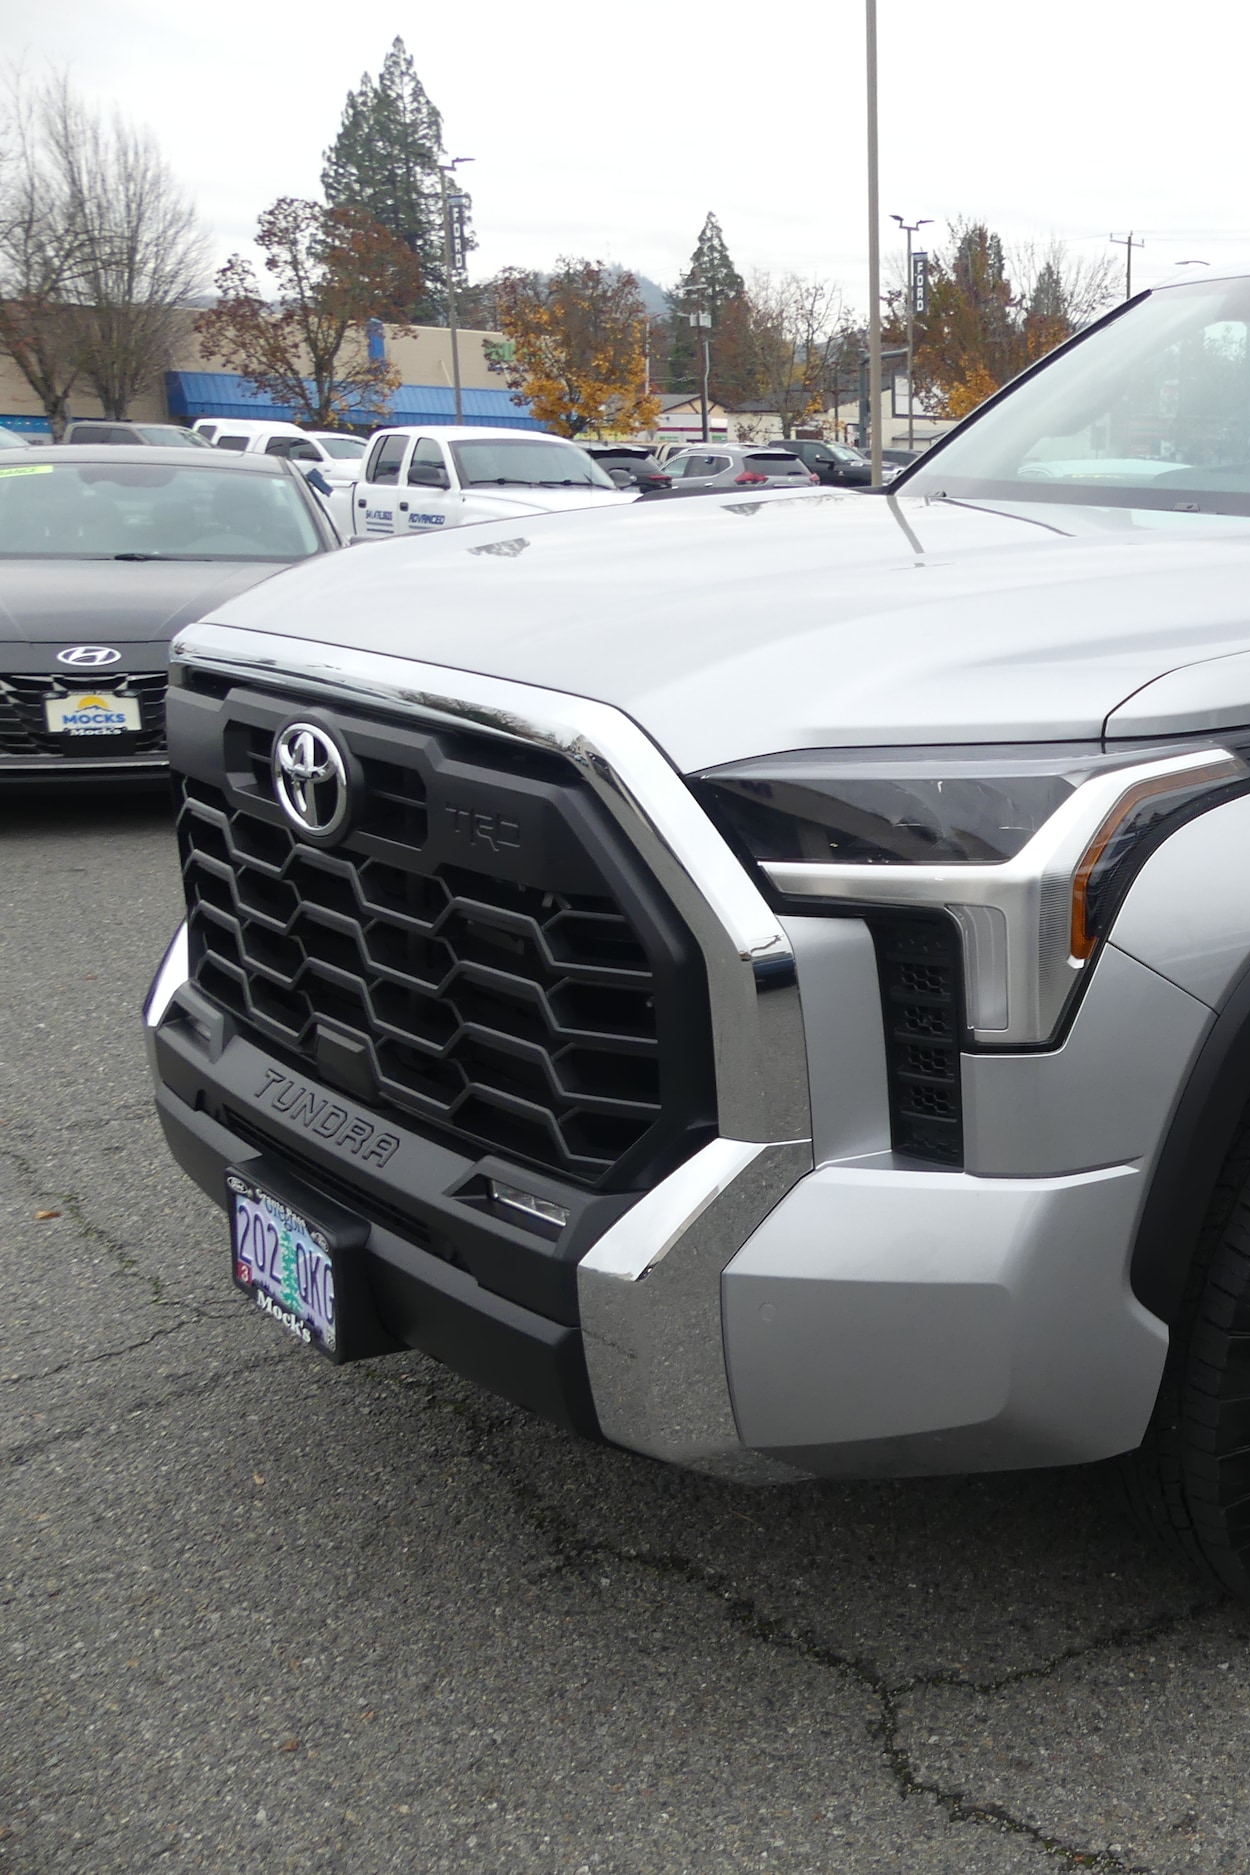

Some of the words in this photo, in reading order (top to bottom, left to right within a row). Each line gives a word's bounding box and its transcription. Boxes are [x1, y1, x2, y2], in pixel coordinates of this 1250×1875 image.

[408, 512, 446, 525] ADVANCED
[62, 713, 126, 725] MOCKS
[445, 802, 521, 853] TRD
[254, 1068, 400, 1169] TUNDRA
[238, 1204, 283, 1285] 202
[257, 1289, 312, 1344] Mock's
